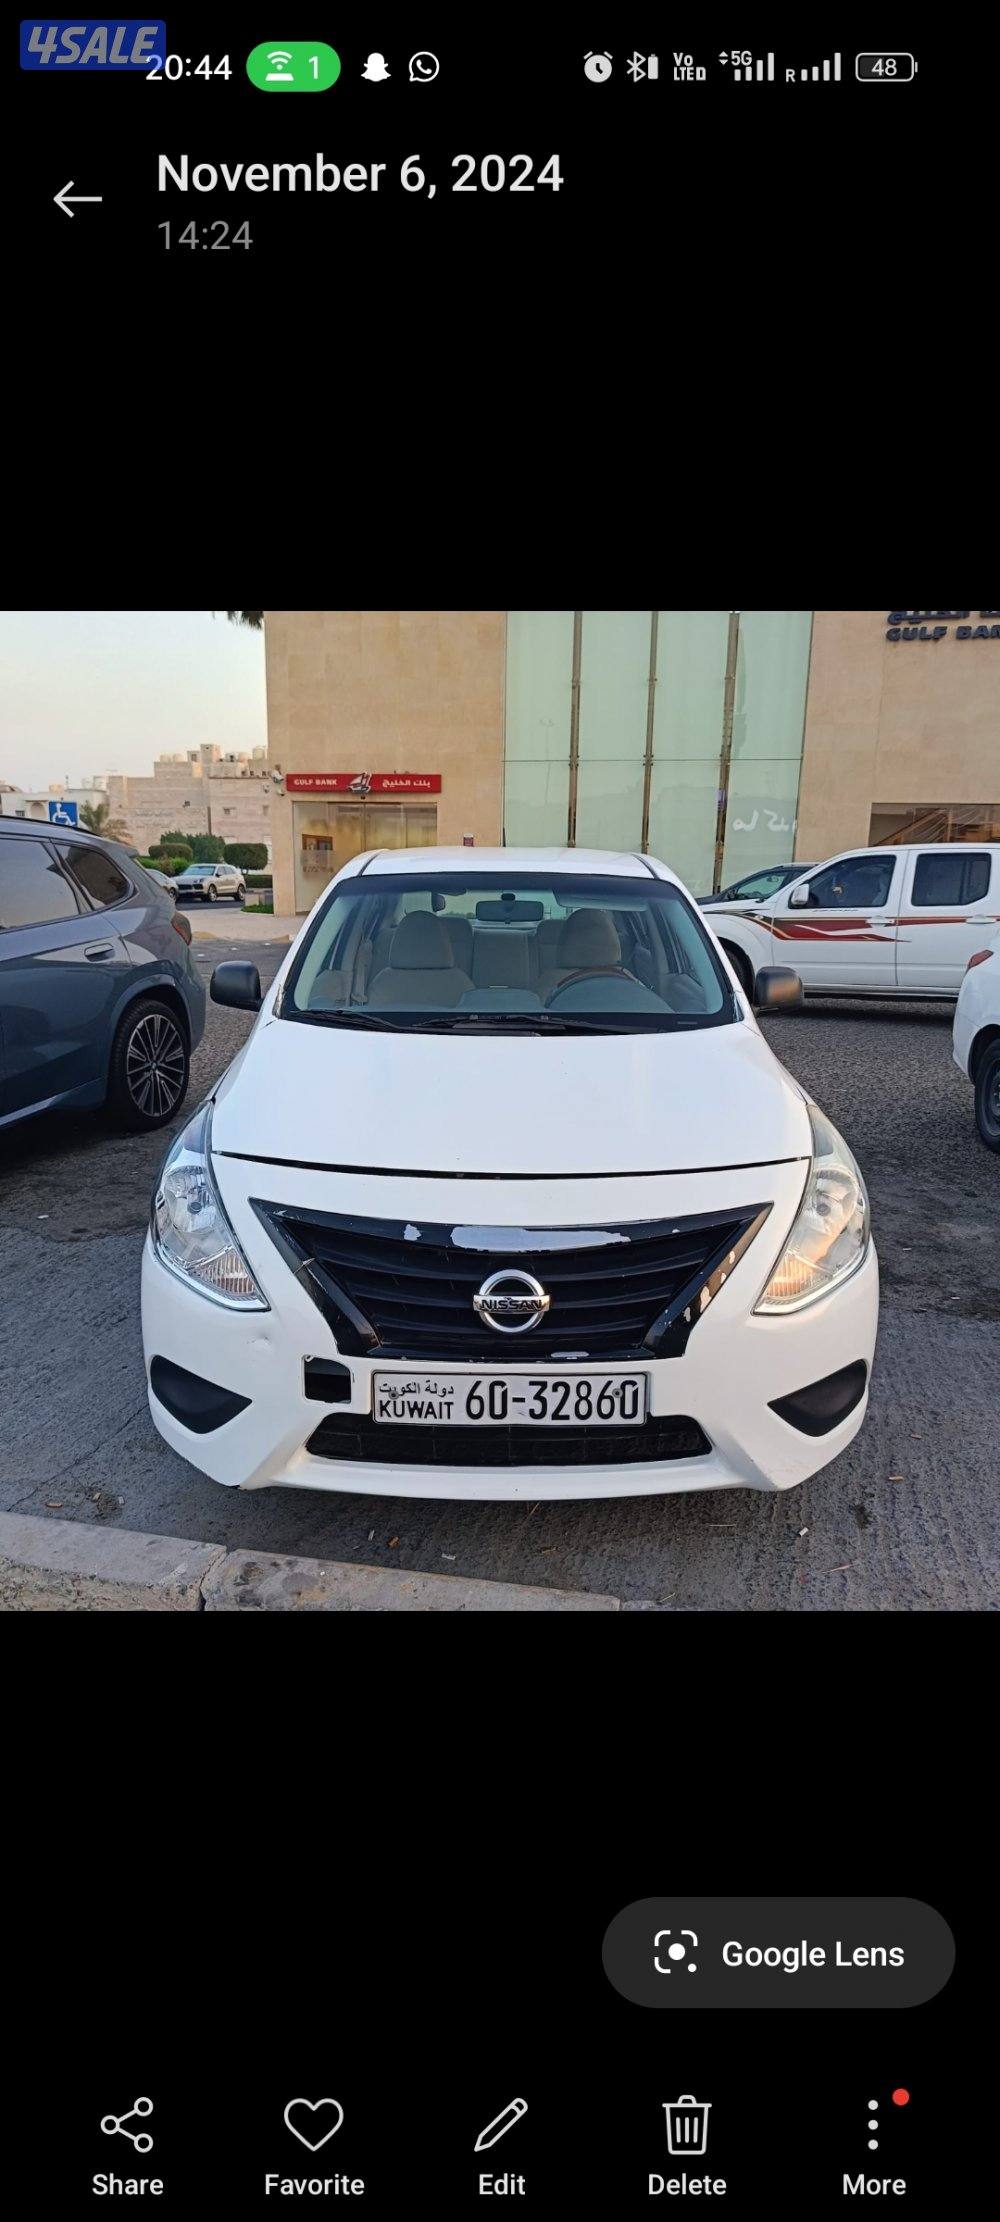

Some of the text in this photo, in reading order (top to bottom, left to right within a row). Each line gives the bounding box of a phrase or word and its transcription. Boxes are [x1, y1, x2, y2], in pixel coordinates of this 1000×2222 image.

[886, 626, 947, 641] GULF
[481, 1299, 542, 1310] NISSAN
[424, 1379, 454, 1398] دولة
[465, 1380, 639, 1420] 60-32860
[379, 1400, 454, 1420] KUWAIT
